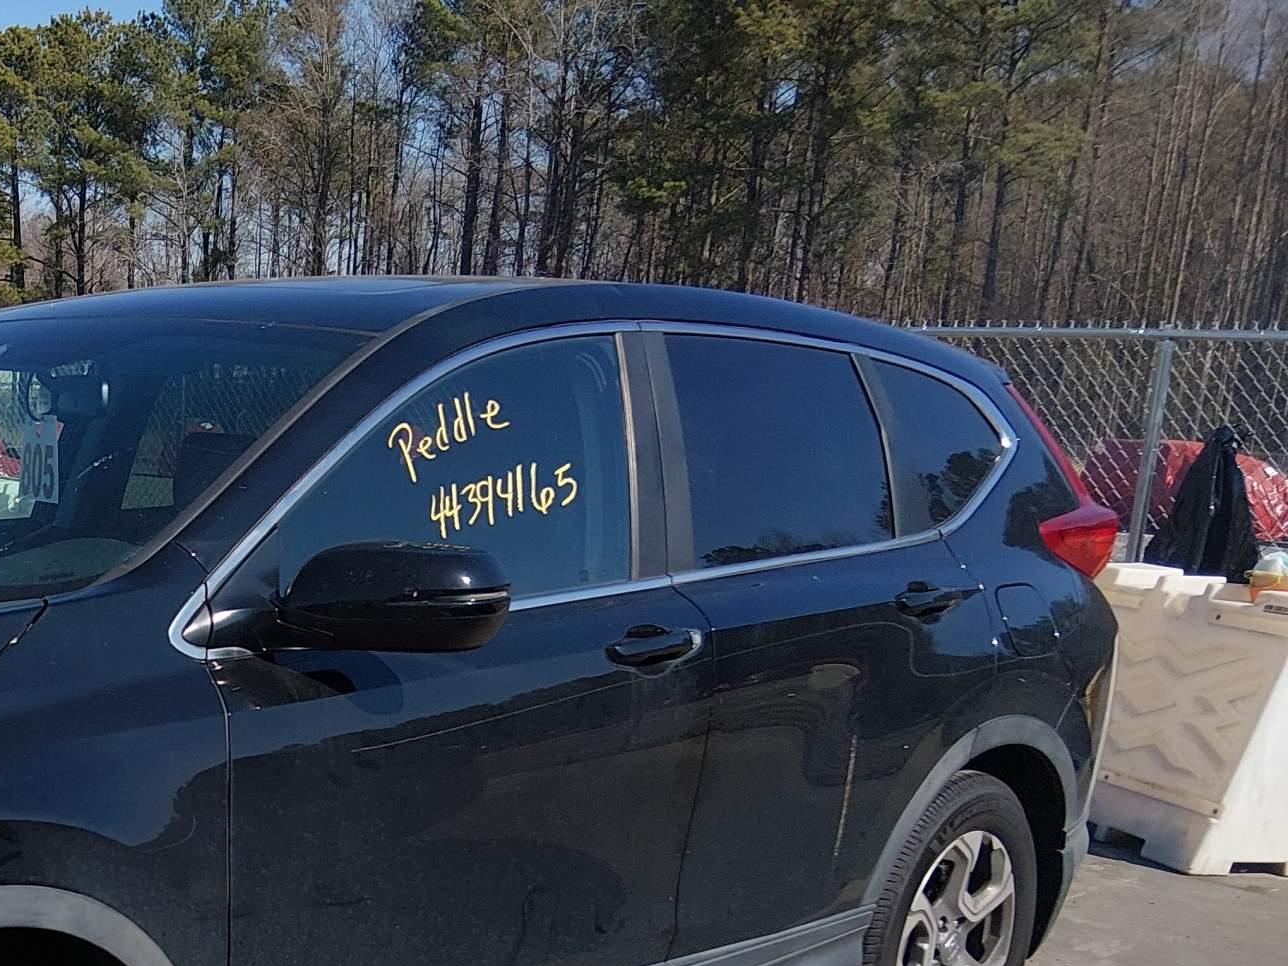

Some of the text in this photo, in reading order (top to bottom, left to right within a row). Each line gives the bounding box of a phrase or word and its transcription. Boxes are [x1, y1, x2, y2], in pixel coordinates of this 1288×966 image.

[21, 443, 56, 499] 805
[387, 391, 510, 483] Peddle
[429, 462, 578, 539] 44394165
